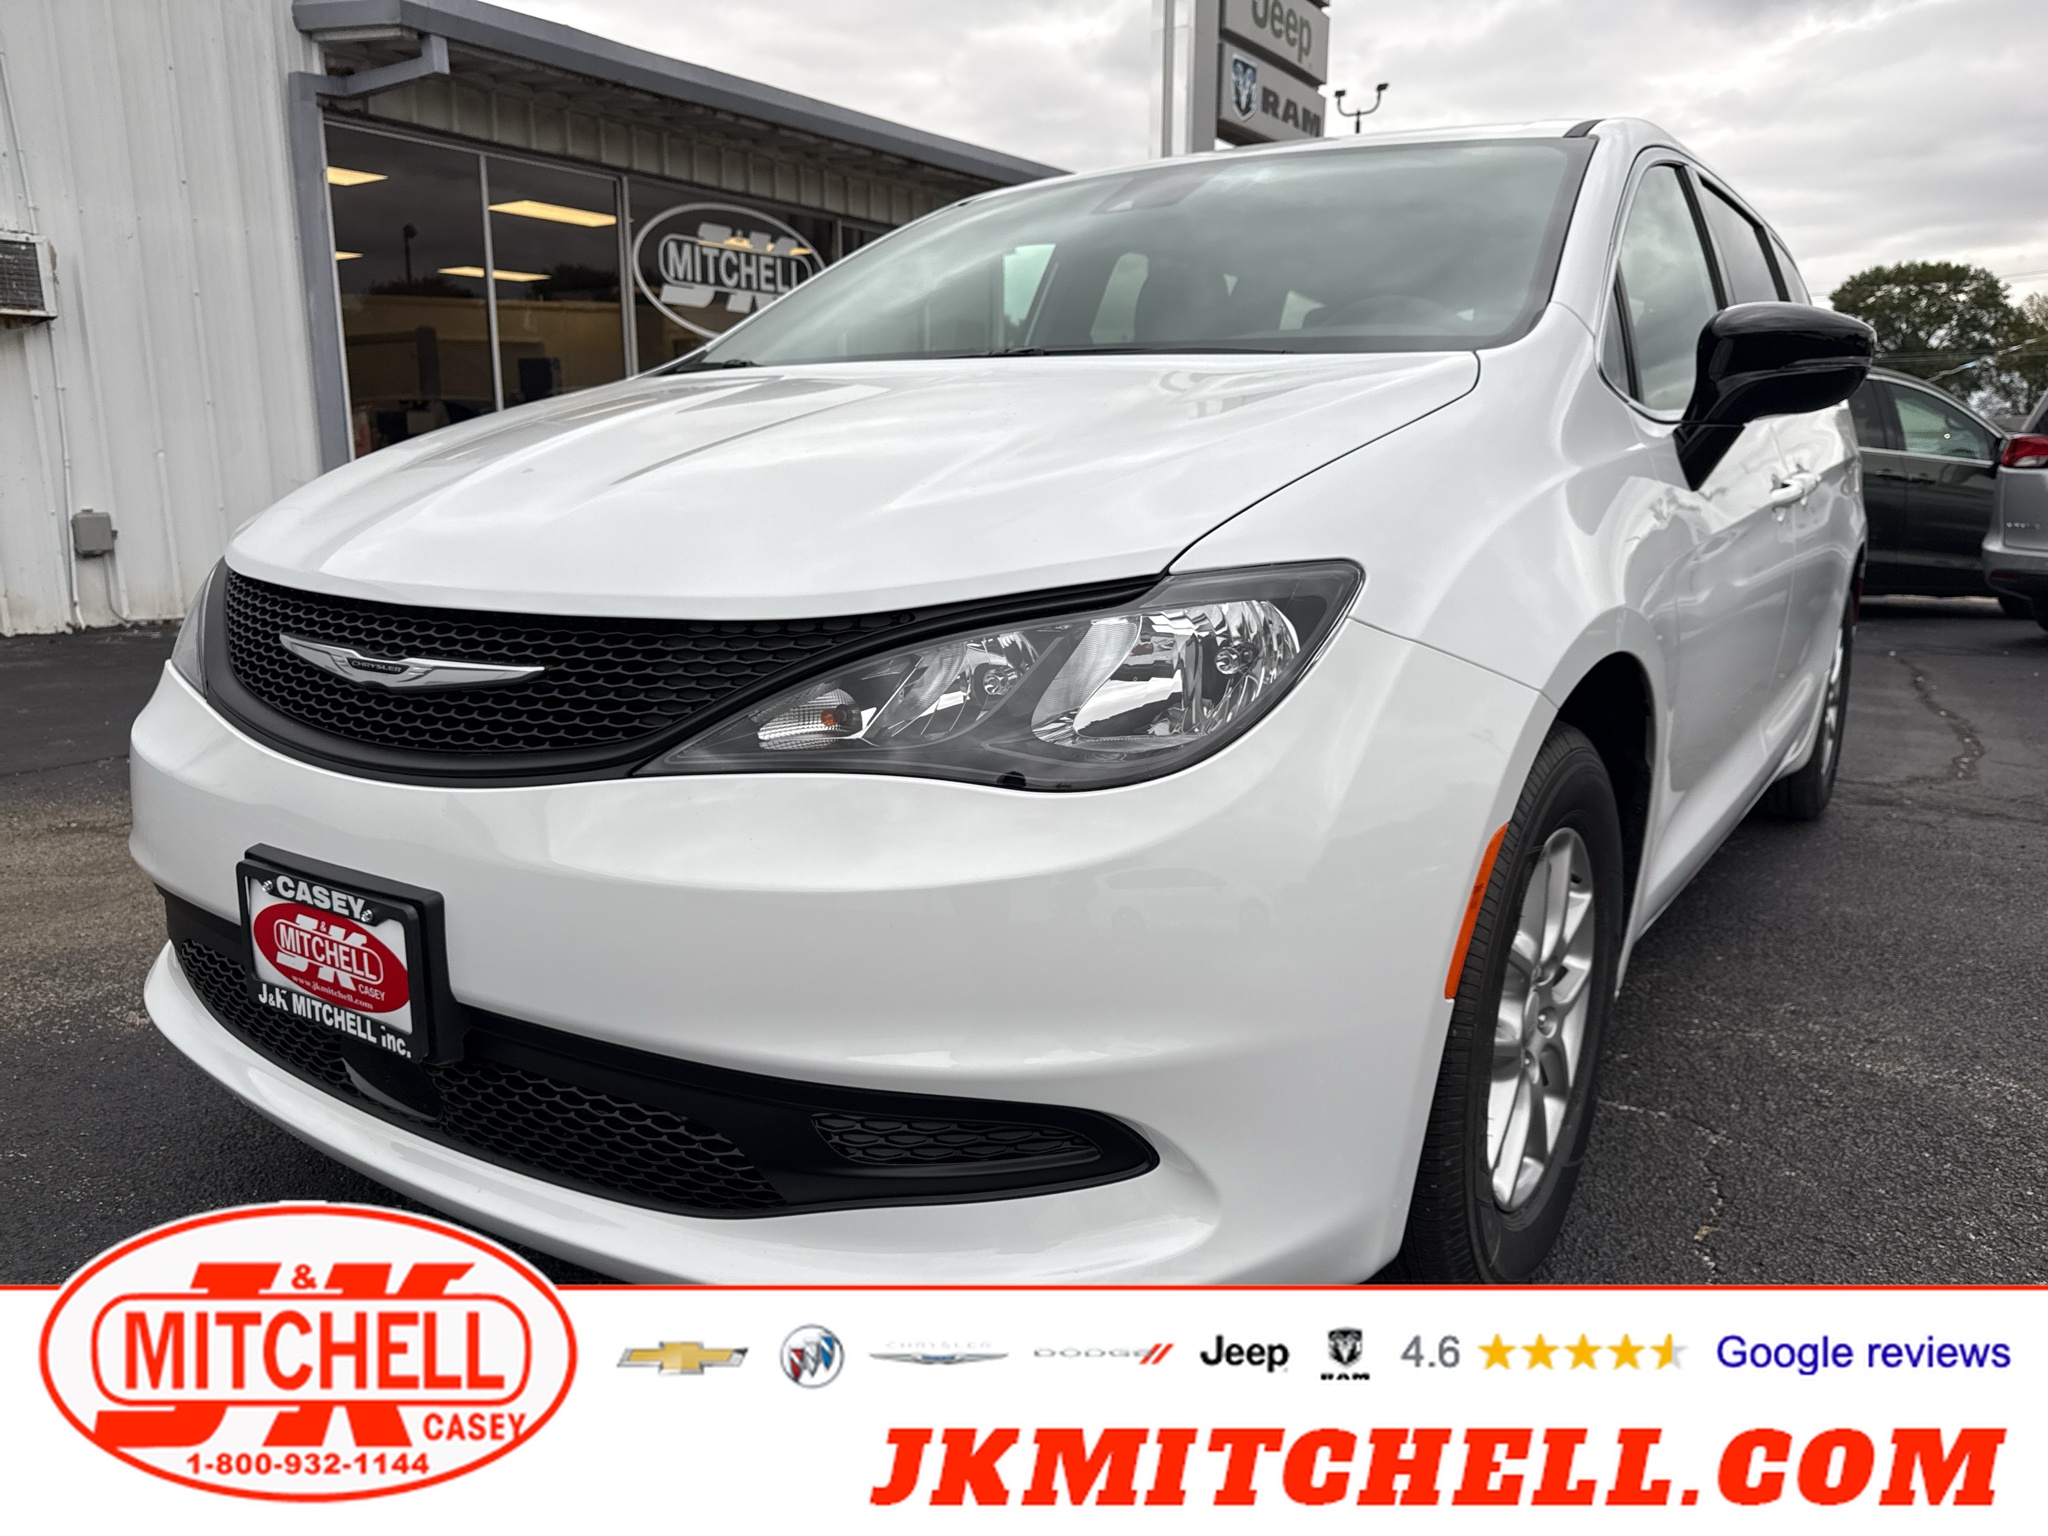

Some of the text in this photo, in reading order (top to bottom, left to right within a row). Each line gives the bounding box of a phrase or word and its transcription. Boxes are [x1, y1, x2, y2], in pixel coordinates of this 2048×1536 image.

[1252, 0, 1313, 64] Jeep
[1262, 86, 1322, 137] RAM
[350, 660, 402, 673] CHRYSLER
[276, 875, 366, 920] CASEY
[279, 923, 378, 981] MITCHELL
[258, 983, 289, 1012] J&K
[291, 992, 378, 1044] MITCHELL
[292, 975, 374, 1010] www.jkmitchell.com
[357, 983, 386, 1002] CASEY
